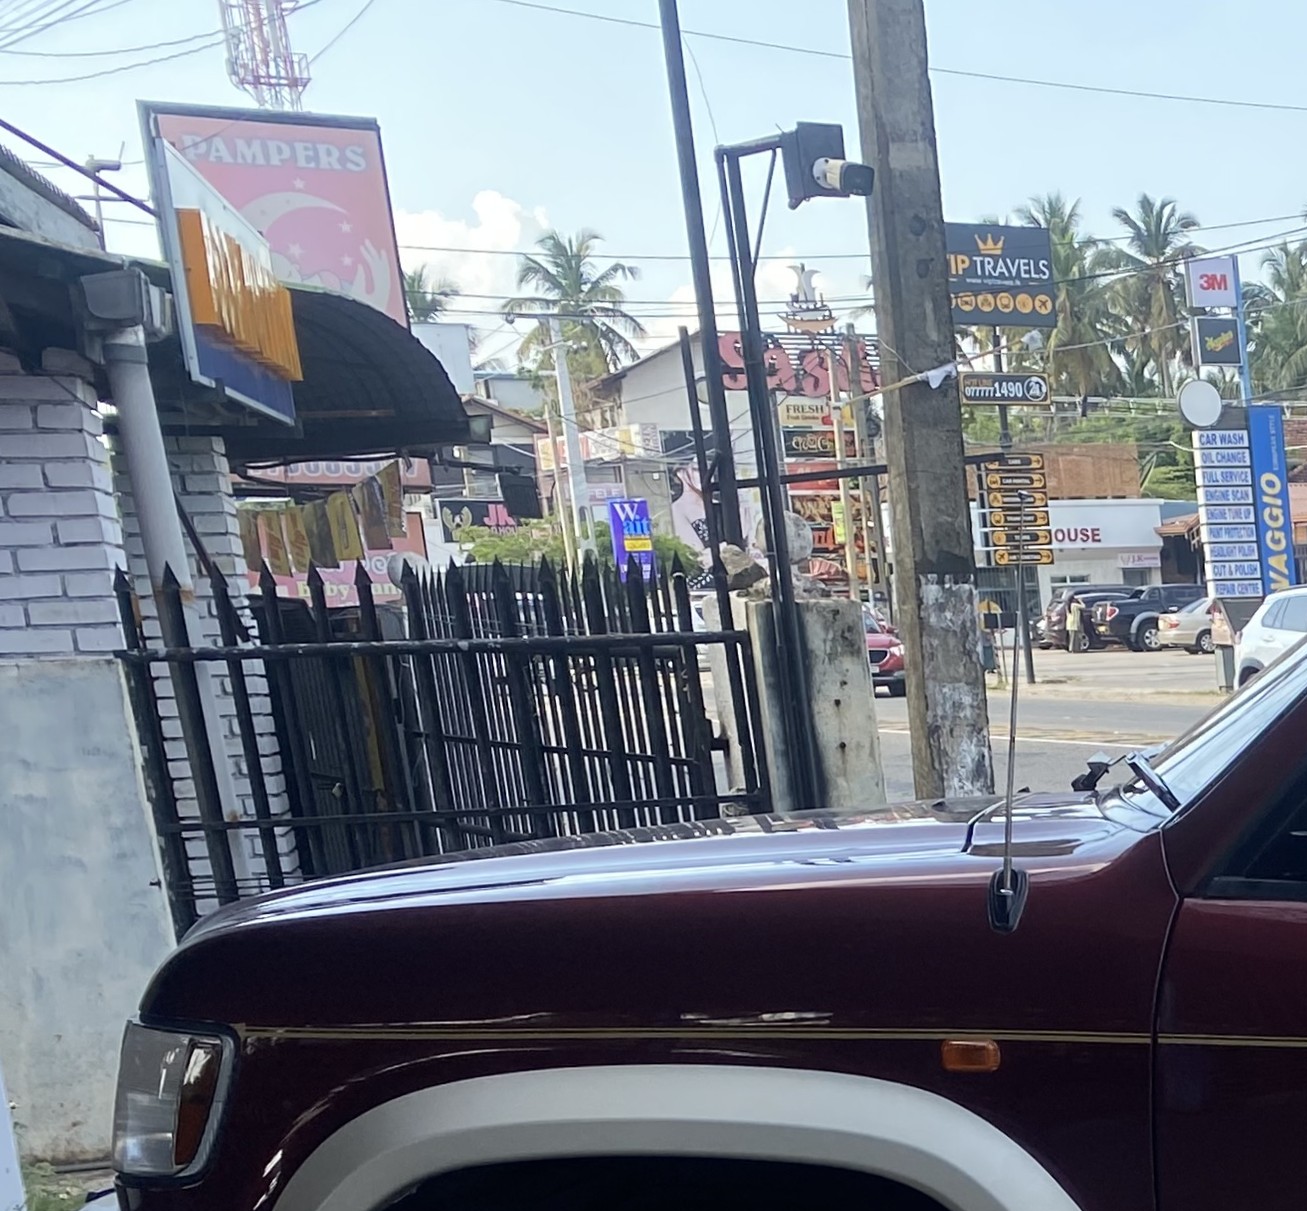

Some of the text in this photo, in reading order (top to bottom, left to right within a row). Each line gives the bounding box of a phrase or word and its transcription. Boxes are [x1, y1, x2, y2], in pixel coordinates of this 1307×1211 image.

[180, 134, 368, 172] PAMPERS
[947, 254, 1050, 279] IP TRAVELS
[1199, 274, 1228, 291] 3M
[786, 404, 824, 414] FRESH
[1199, 432, 1245, 446] CAR WASH
[1202, 451, 1248, 464] OIL CHANGE
[1203, 470, 1250, 483] FULL SERVICE
[1205, 489, 1250, 502] ENGINE SCAN
[1055, 528, 1102, 543] OUSE
[1213, 563, 1258, 576] CUT & POLISH
[1215, 583, 1237, 595] REPAIR
